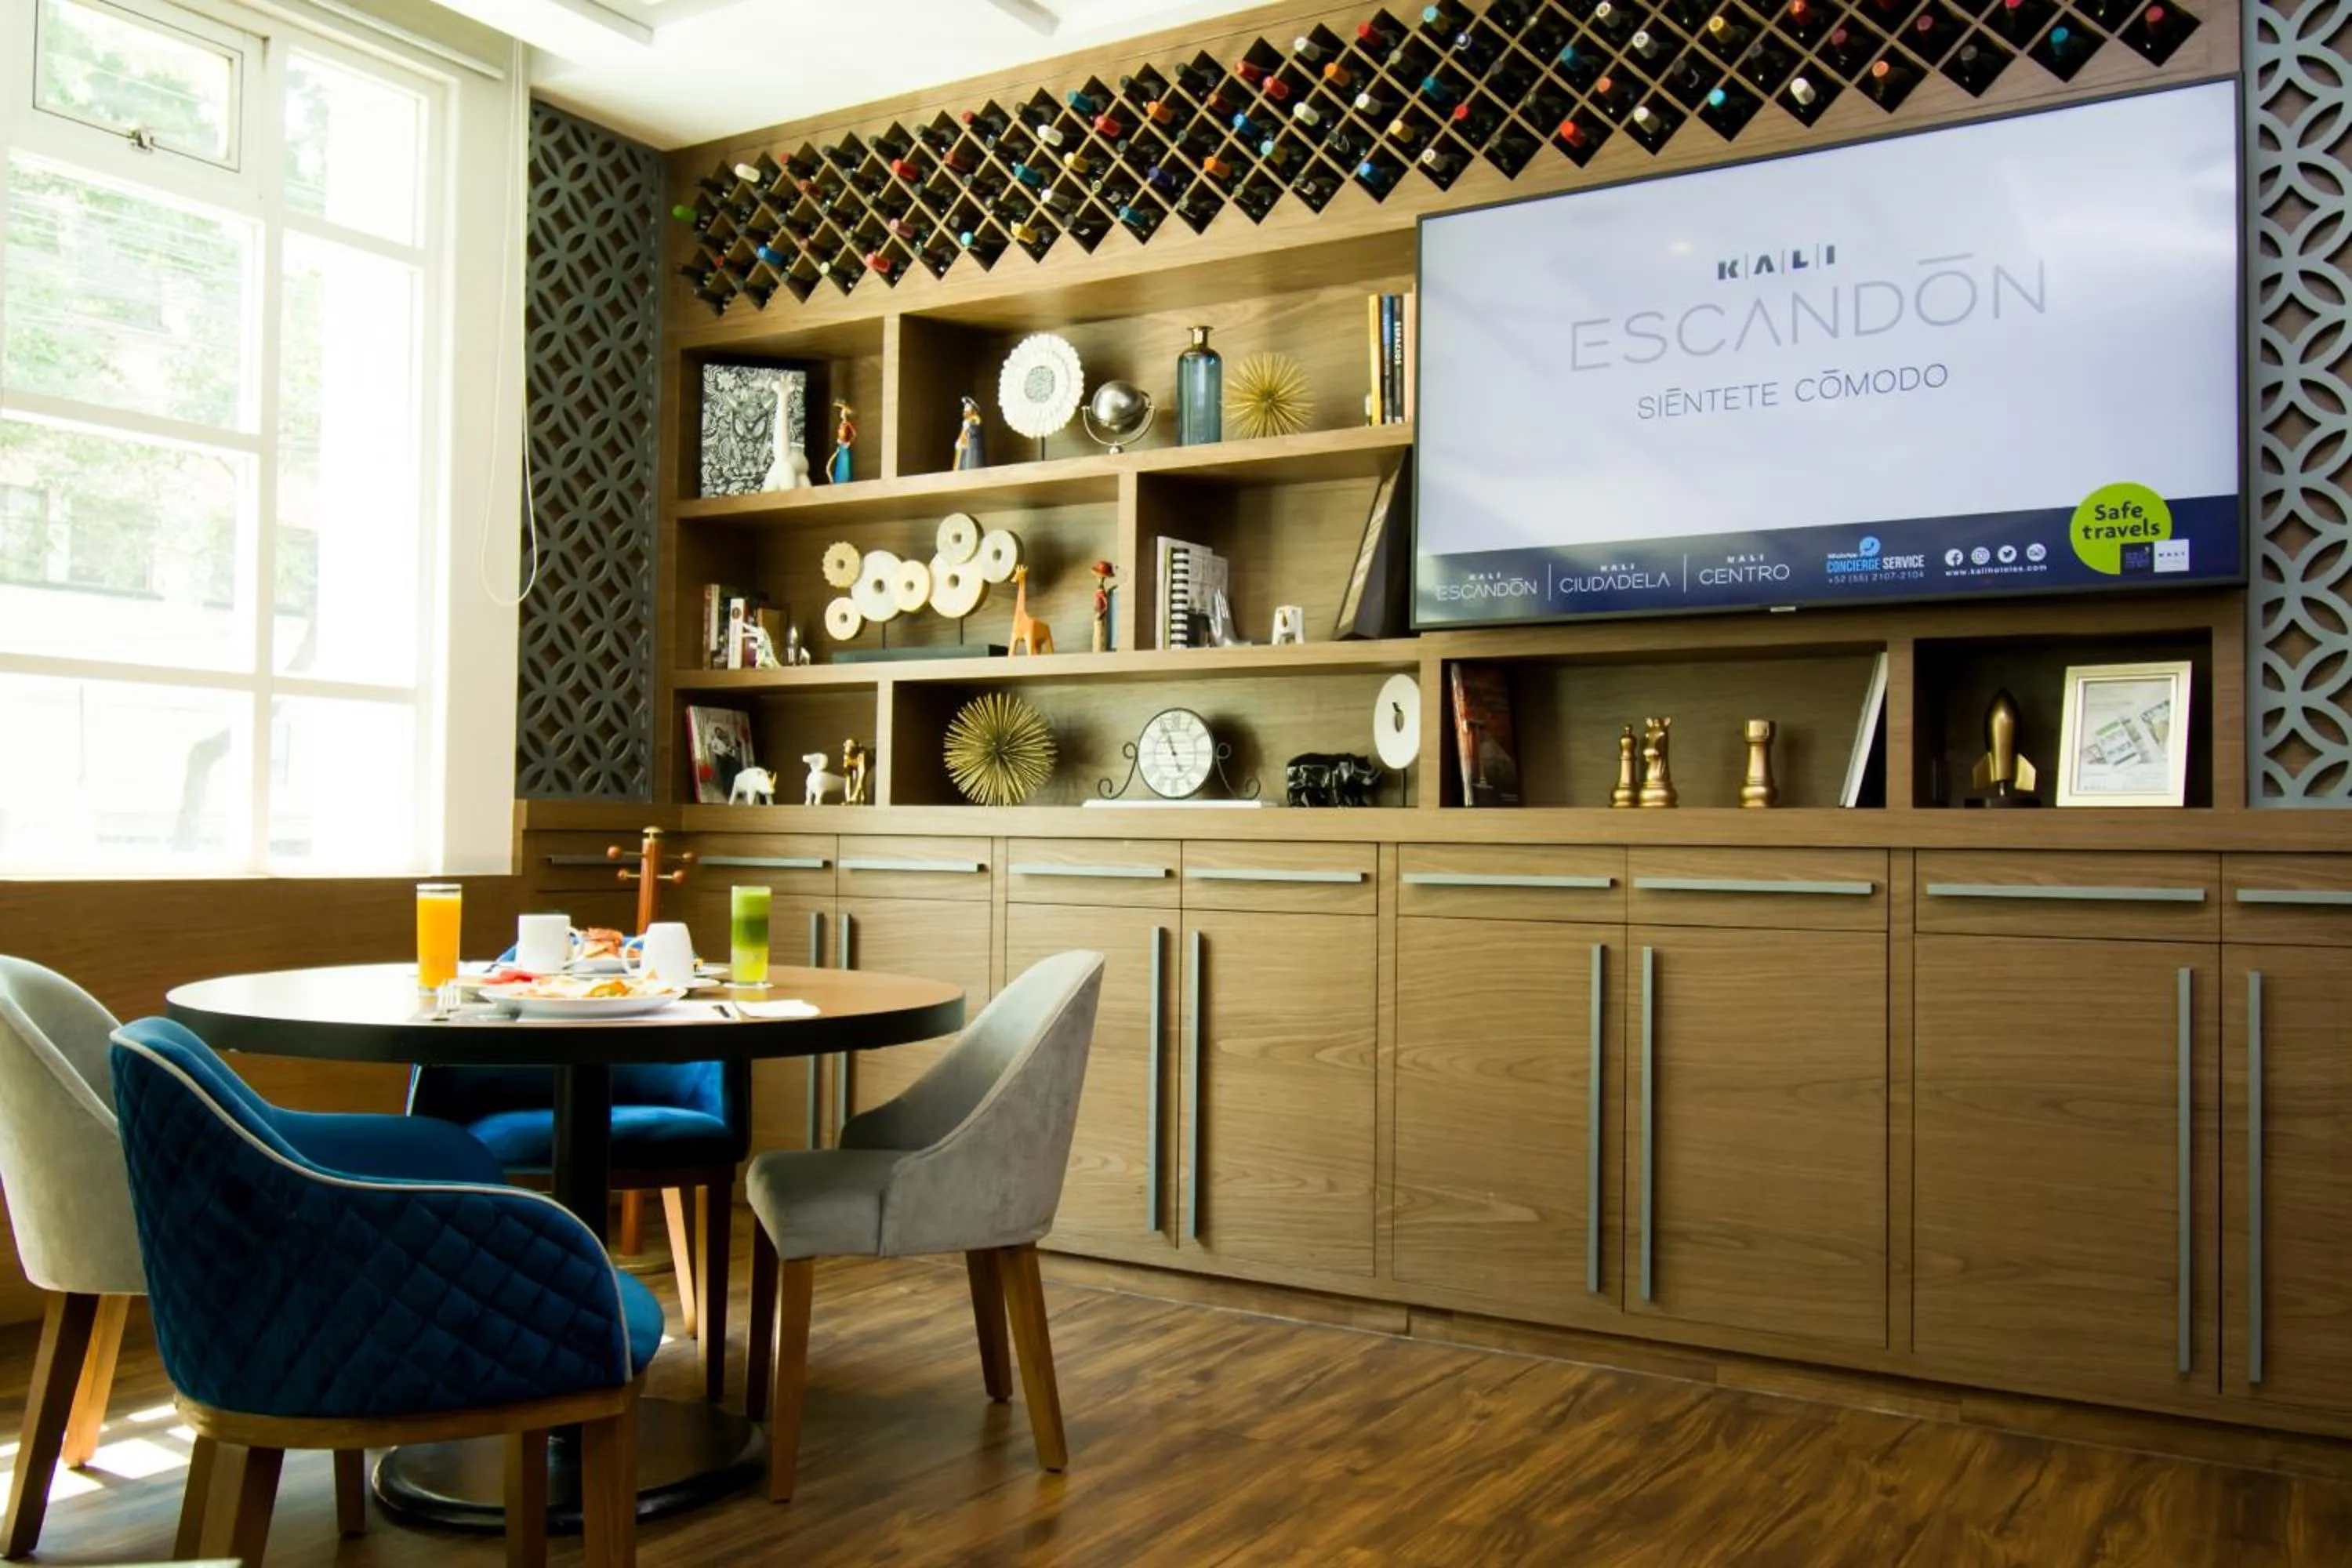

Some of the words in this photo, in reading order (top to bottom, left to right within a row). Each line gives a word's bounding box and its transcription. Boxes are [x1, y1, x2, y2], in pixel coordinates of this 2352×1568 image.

[2094, 501, 2143, 521] Safe
[2082, 518, 2161, 540] travels
[1826, 558, 1881, 573] CONCIERGE
[1882, 554, 1926, 570] SERVICE
[1559, 571, 1671, 594] CIUDADELA
[1699, 564, 1791, 586] CENTRO
